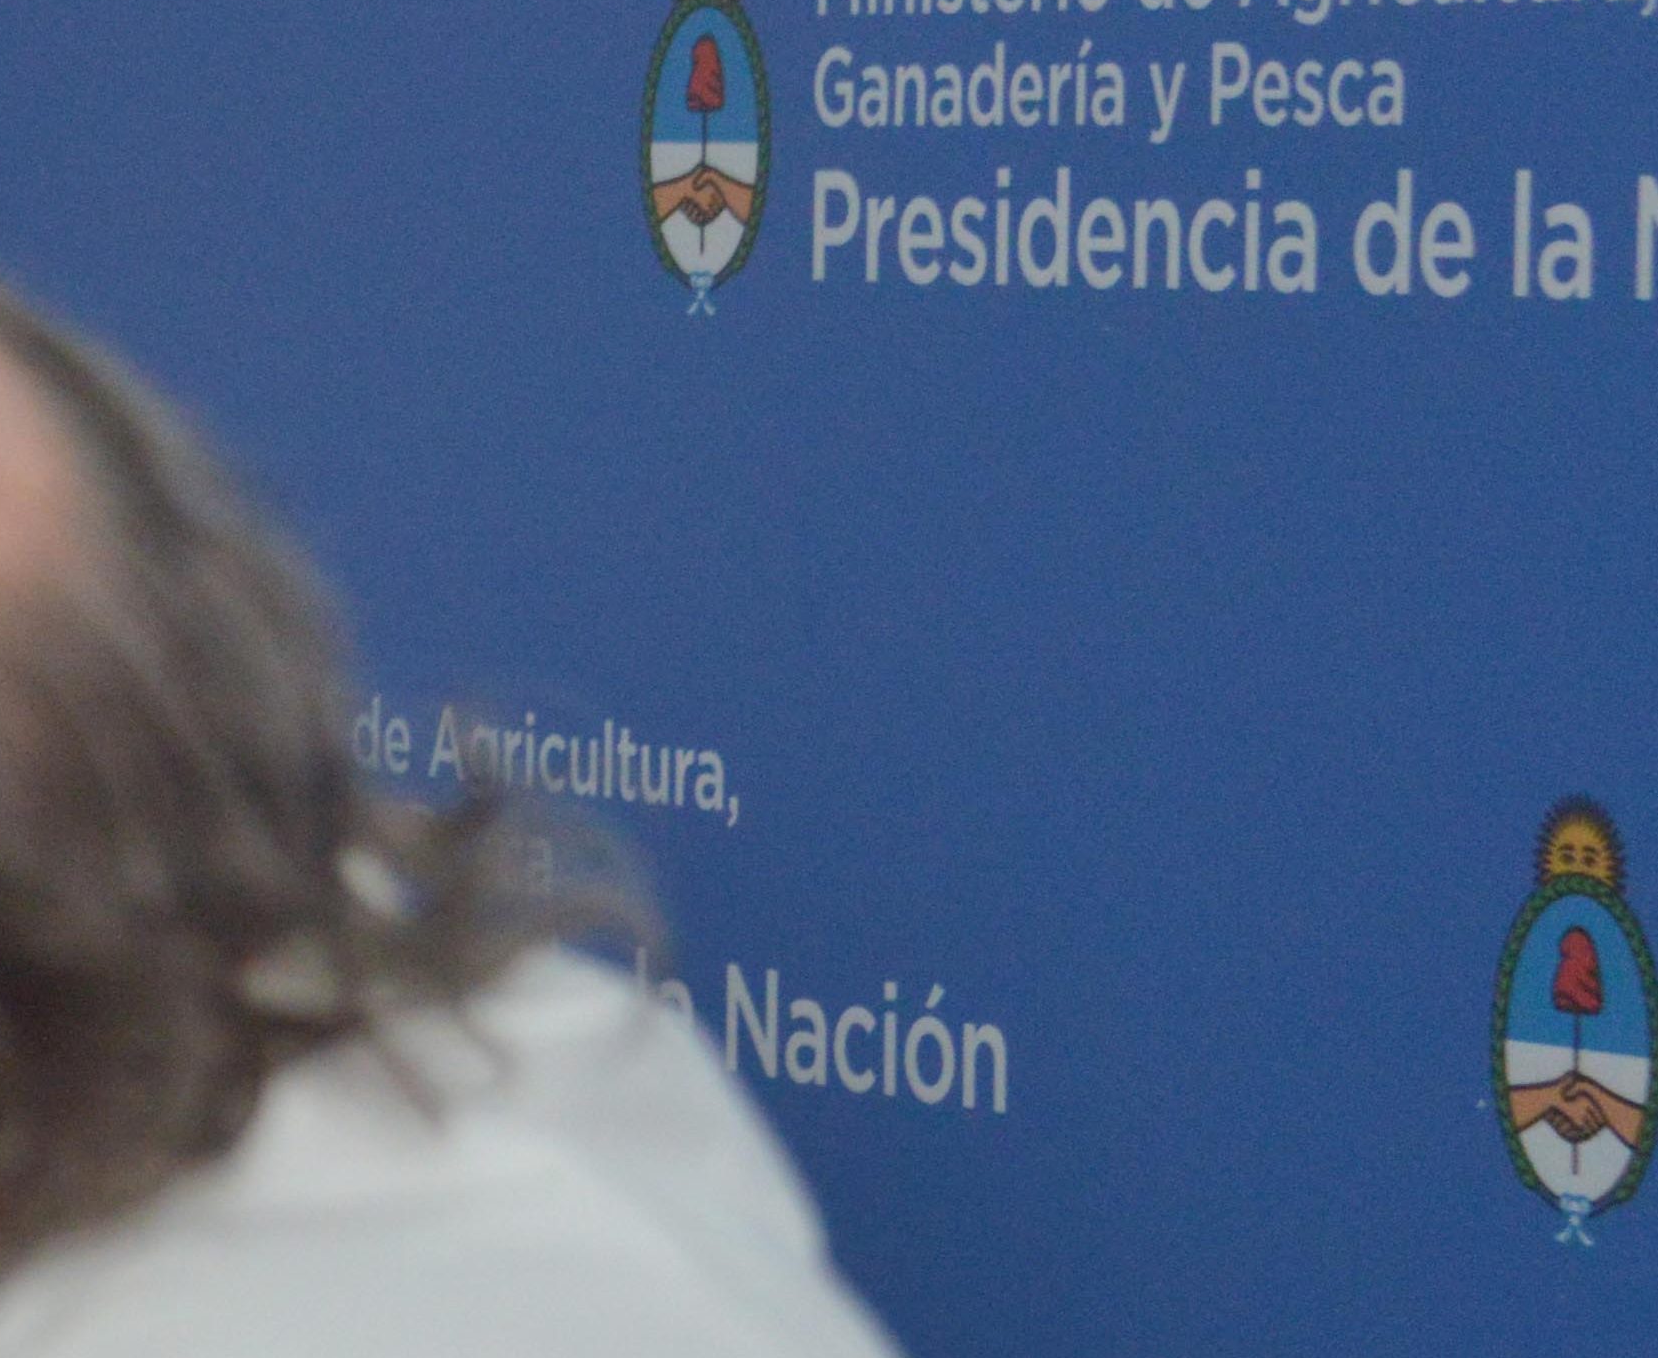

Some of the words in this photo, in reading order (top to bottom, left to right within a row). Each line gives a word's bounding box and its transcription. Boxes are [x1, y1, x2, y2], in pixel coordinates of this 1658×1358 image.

[812, 38, 1126, 129] Ganadería
[1148, 61, 1187, 145] y
[1209, 40, 1406, 128] Pesca
[811, 165, 1318, 295] Presidencia
[1352, 168, 1477, 299] de
[1512, 168, 1595, 301] la
[725, 961, 1008, 1112] Nación
